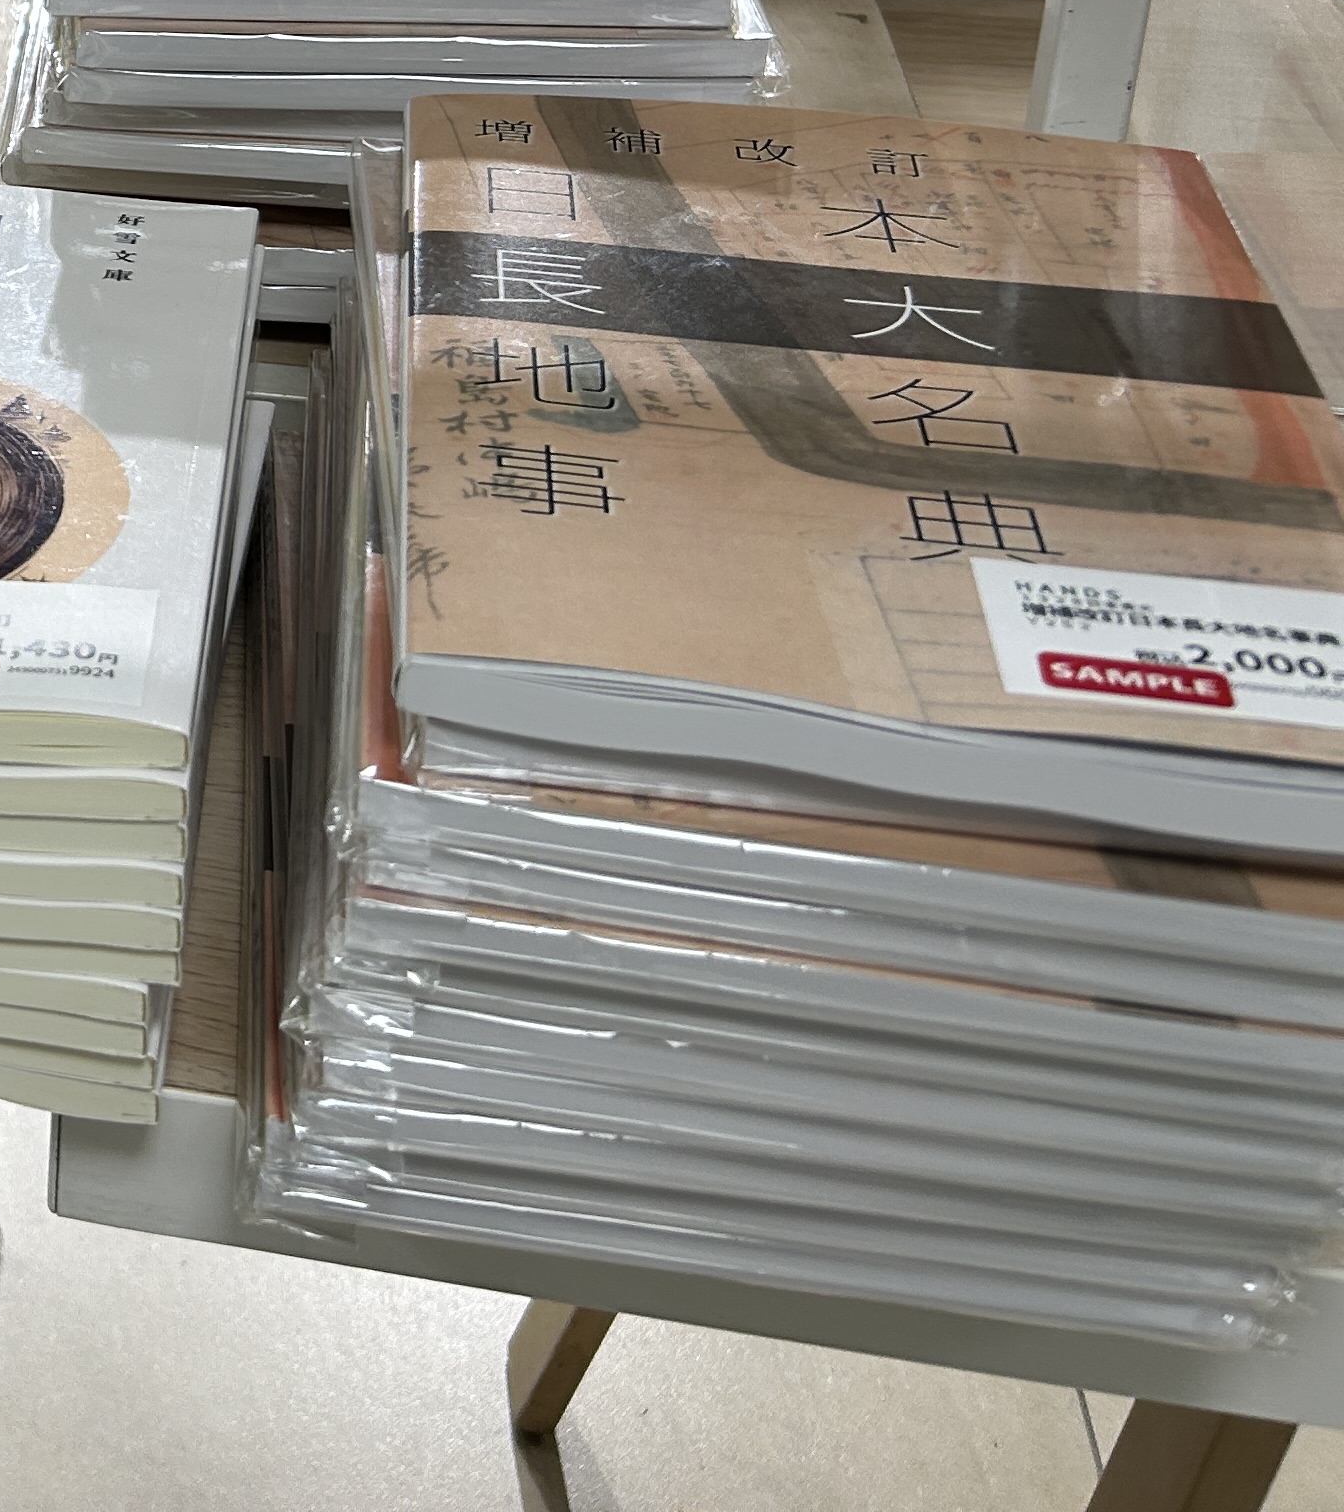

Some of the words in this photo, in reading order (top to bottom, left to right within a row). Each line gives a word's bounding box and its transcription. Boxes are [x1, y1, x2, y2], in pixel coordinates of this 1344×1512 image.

[474, 118, 928, 180] 増補改訂
[102, 213, 146, 282] 好雪文庫
[1015, 579, 1121, 600] HANDS
[1049, 661, 1220, 698] SAMPLE
